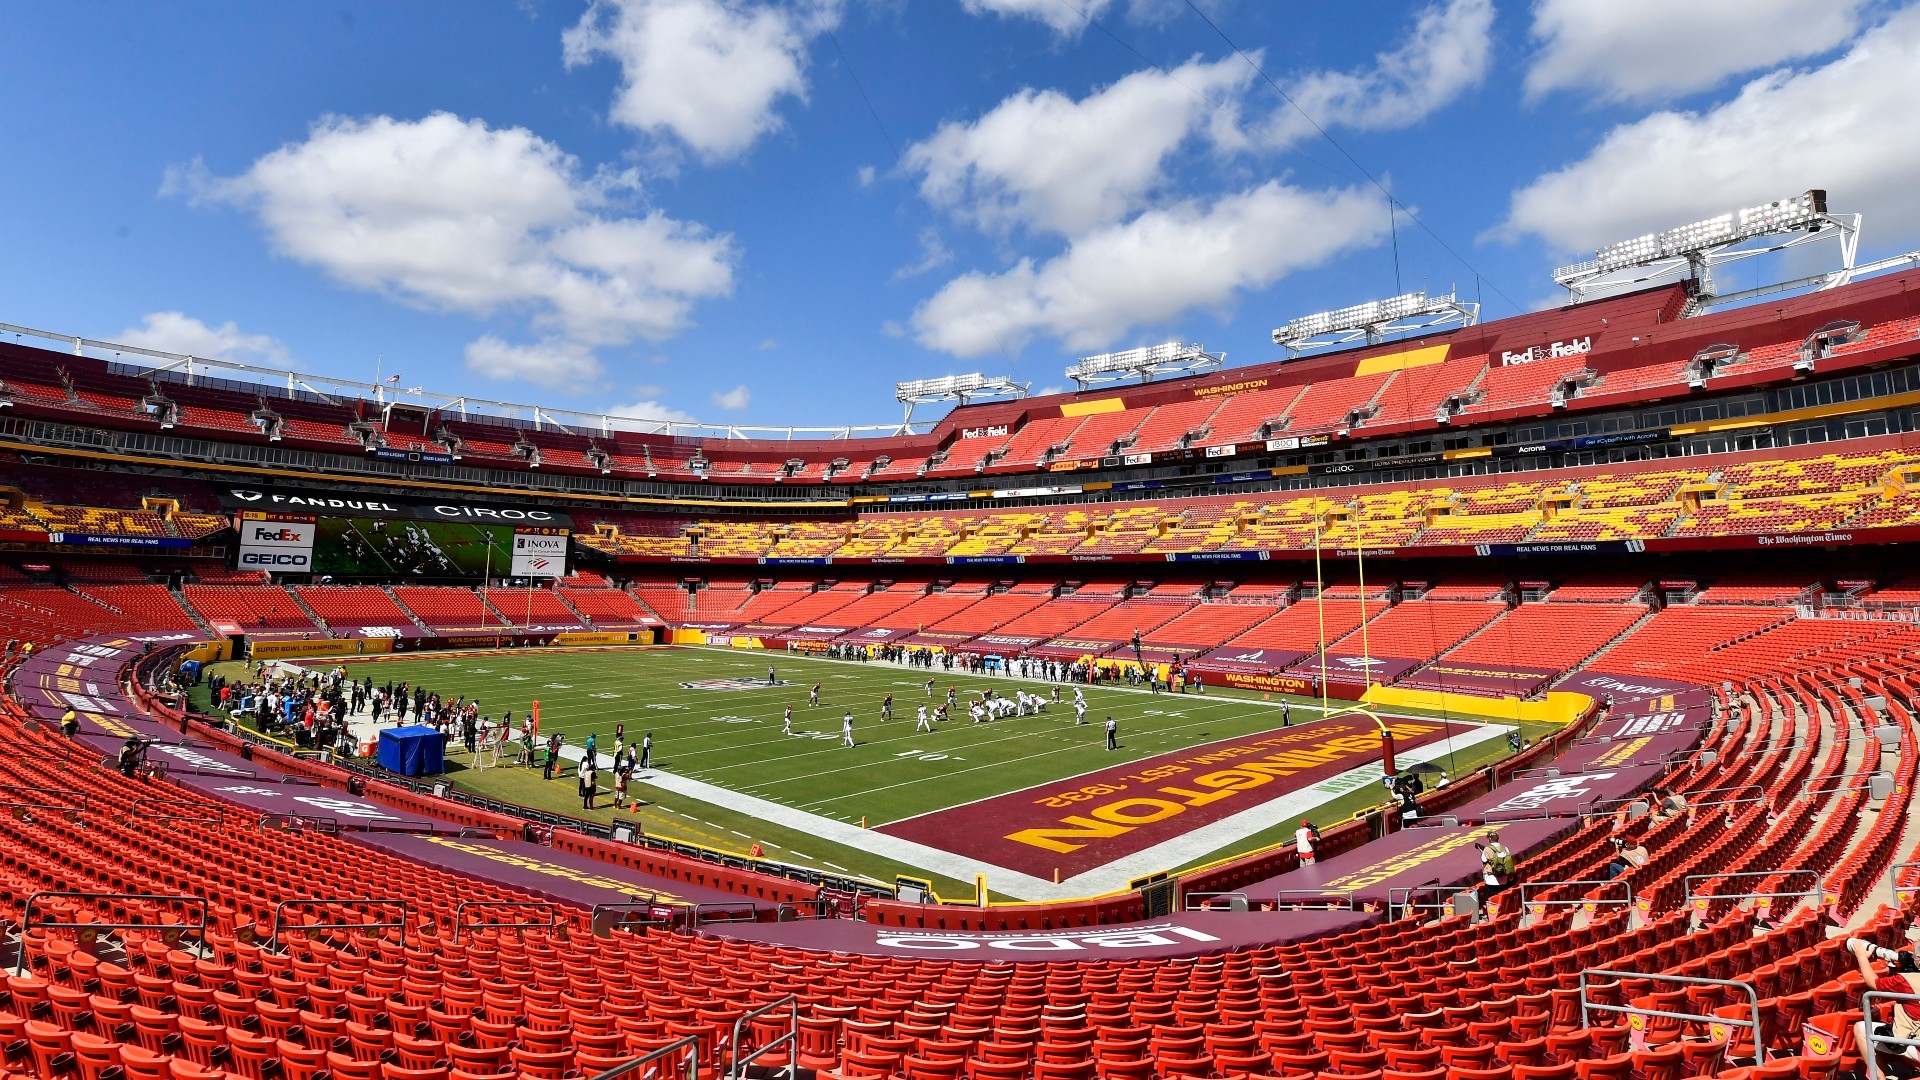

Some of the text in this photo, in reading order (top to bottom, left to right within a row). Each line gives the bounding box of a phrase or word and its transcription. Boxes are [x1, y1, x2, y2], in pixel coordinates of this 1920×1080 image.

[1502, 336, 1591, 366] FedExField
[1194, 380, 1268, 396] WASHINGTON
[962, 424, 1008, 439] FedExField
[1208, 446, 1231, 456] FedEx
[1274, 440, 1292, 448] BDO
[1518, 445, 1546, 453] Acronis
[1126, 456, 1147, 464] FedEx
[272, 494, 398, 512] FANDUEL
[255, 528, 302, 542] FedEx
[1758, 533, 1852, 546] The Washington Times
[527, 540, 560, 549] INOVA
[242, 553, 308, 566] GEICO
[1428, 666, 1548, 678] WASHINGTON
[1225, 673, 1304, 688] WASHINGTON
[1254, 724, 1354, 748] FOOTBALL
[1003, 723, 1444, 854] WASHINGTON
[1033, 784, 1126, 807] 1932
